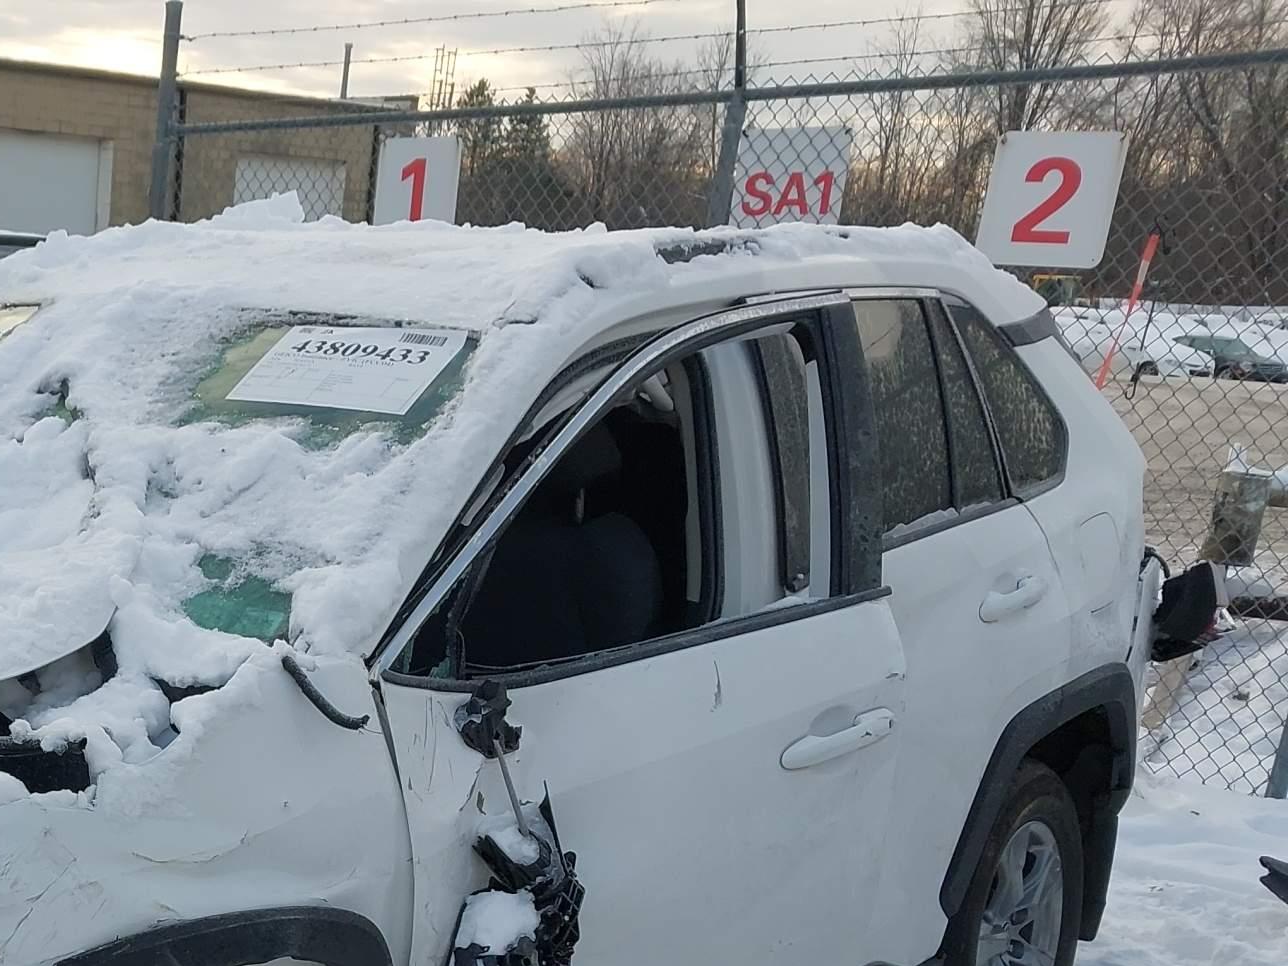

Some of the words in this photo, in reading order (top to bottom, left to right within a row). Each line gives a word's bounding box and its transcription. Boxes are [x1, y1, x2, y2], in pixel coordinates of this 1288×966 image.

[400, 157, 427, 222] 1
[742, 170, 835, 216] SA1
[1010, 156, 1082, 244] 2
[291, 339, 431, 366] 43809433
